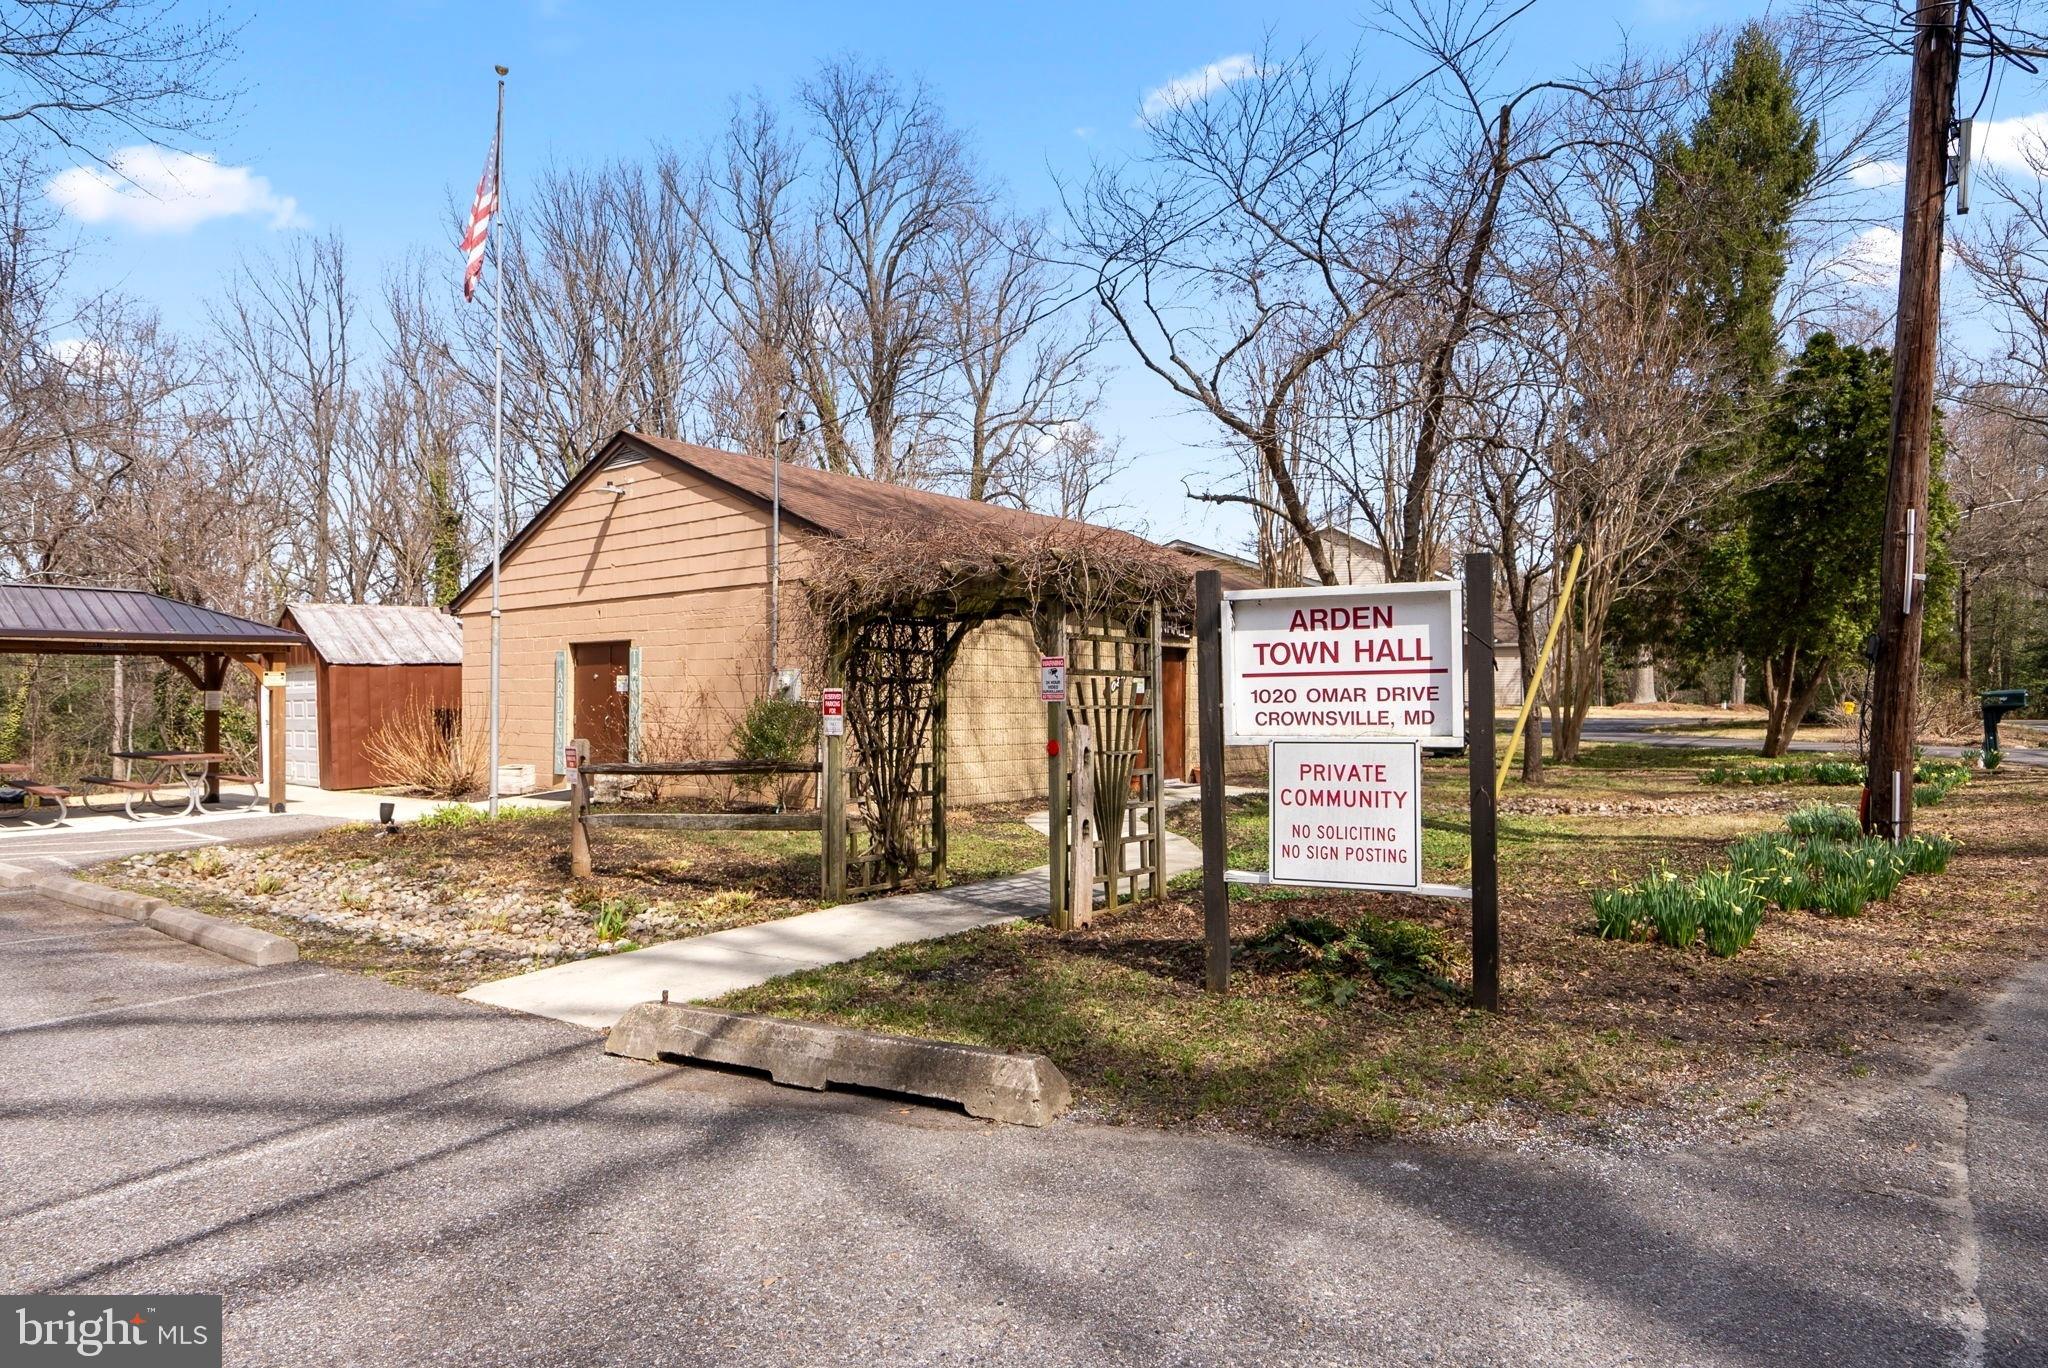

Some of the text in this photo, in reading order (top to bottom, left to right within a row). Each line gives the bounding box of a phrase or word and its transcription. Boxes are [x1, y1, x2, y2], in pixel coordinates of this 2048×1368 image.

[1289, 605, 1393, 632] ARDEN
[1253, 637, 1433, 666] TOWN HALL
[1250, 685, 1440, 704] 1020 OMAR DRIVE
[1255, 710, 1435, 728] CROWNSVILLE, MD
[1300, 764, 1387, 782] PRIVATE
[1280, 788, 1408, 809] COMMUNITY
[1292, 824, 1396, 842] NO SOLICITING
[1282, 844, 1407, 864] NO SIGN POSTING
